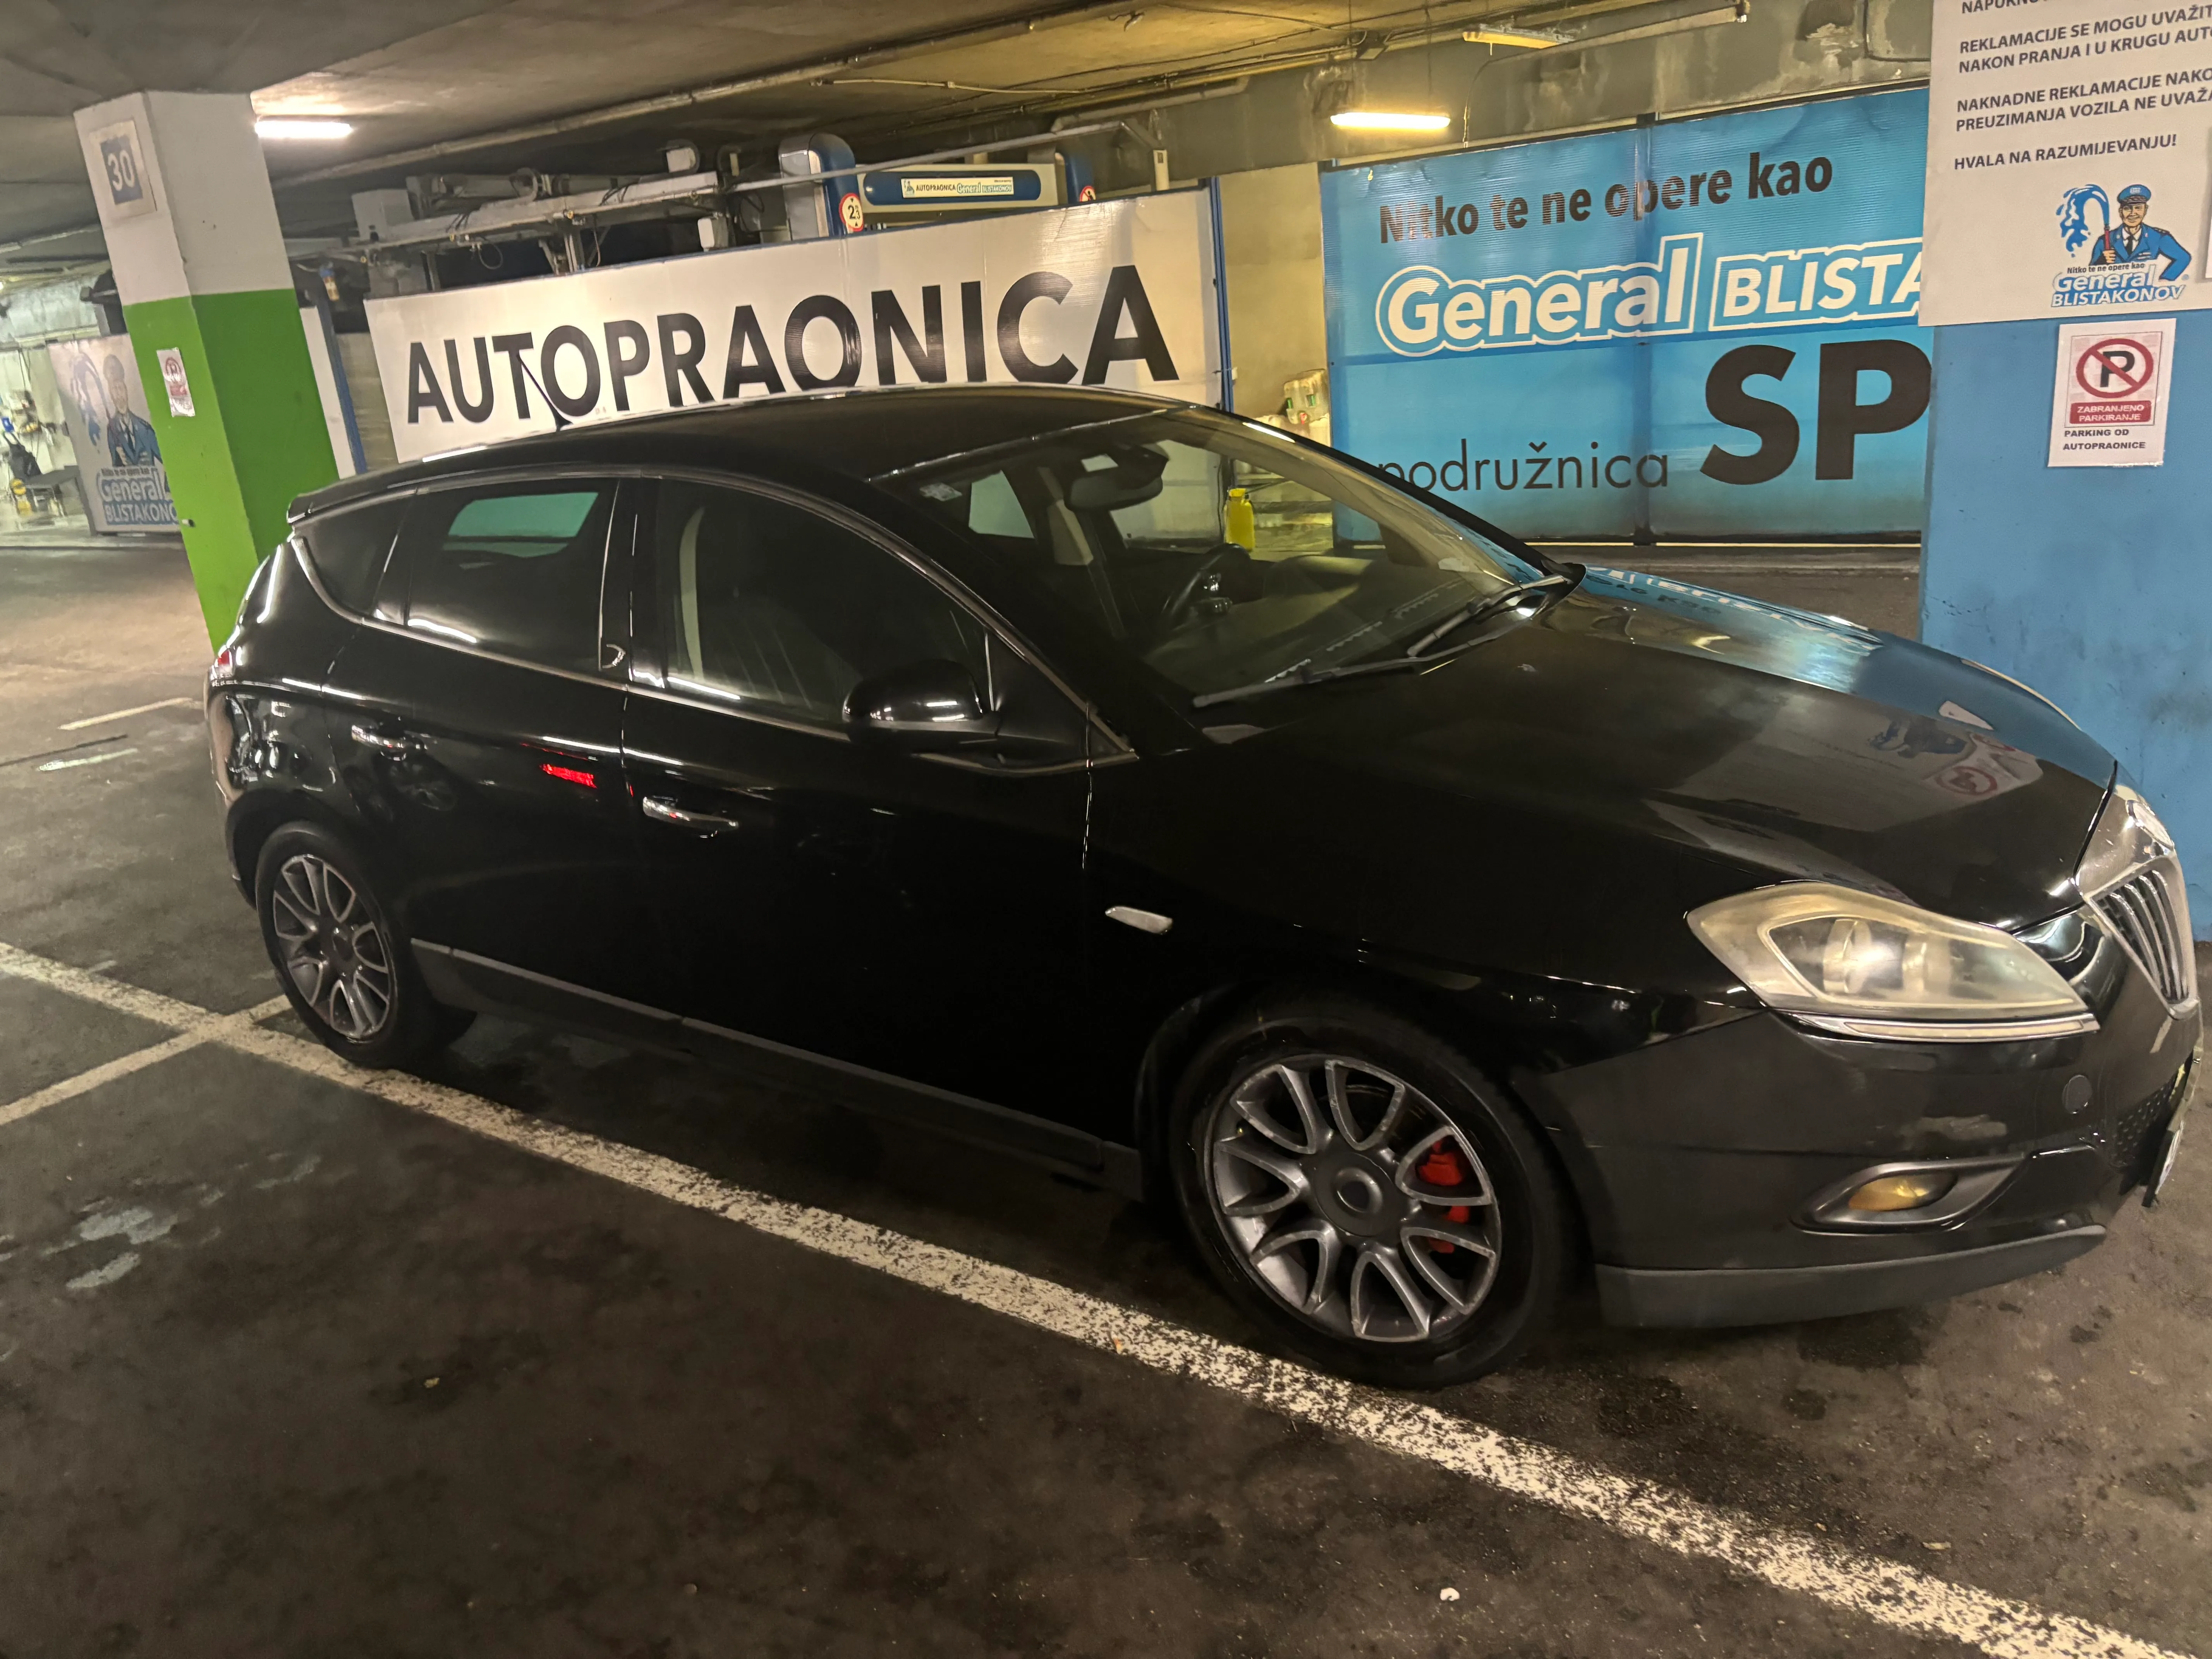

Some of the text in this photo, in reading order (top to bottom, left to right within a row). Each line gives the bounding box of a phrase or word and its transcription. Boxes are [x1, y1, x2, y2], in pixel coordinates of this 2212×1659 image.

[1959, 26, 2212, 73] NAKON PRANJA I U KRUGU AUT
[1960, 26, 2066, 53] REKLAMACIJE
[2070, 23, 2090, 38] SE
[2094, 14, 2147, 34] MOGU
[1957, 89, 2045, 112] NAKNADNE
[2049, 74, 2162, 101] REKLAMACIJE
[1956, 107, 2066, 132] PREUZIMANJA
[2070, 99, 2129, 118] VOZILA
[2134, 96, 2157, 110] NE
[108, 149, 135, 191] 30
[1954, 134, 2177, 170] HVALA NA RAZUMIJEVANJU!
[1380, 151, 1832, 244] Nitko te ne opere kao
[1388, 247, 1689, 344] General
[2051, 285, 2186, 307] BLISTAKONOV
[2053, 264, 2156, 292] General
[407, 265, 1179, 424] AUTOPRAONICA
[1700, 339, 1932, 485] SP
[2077, 404, 2145, 413] ZABRANJENO
[2079, 413, 2141, 422] PARKIRANJE
[2063, 441, 2146, 451] AUTOPRAONICE
[97, 470, 163, 502] General
